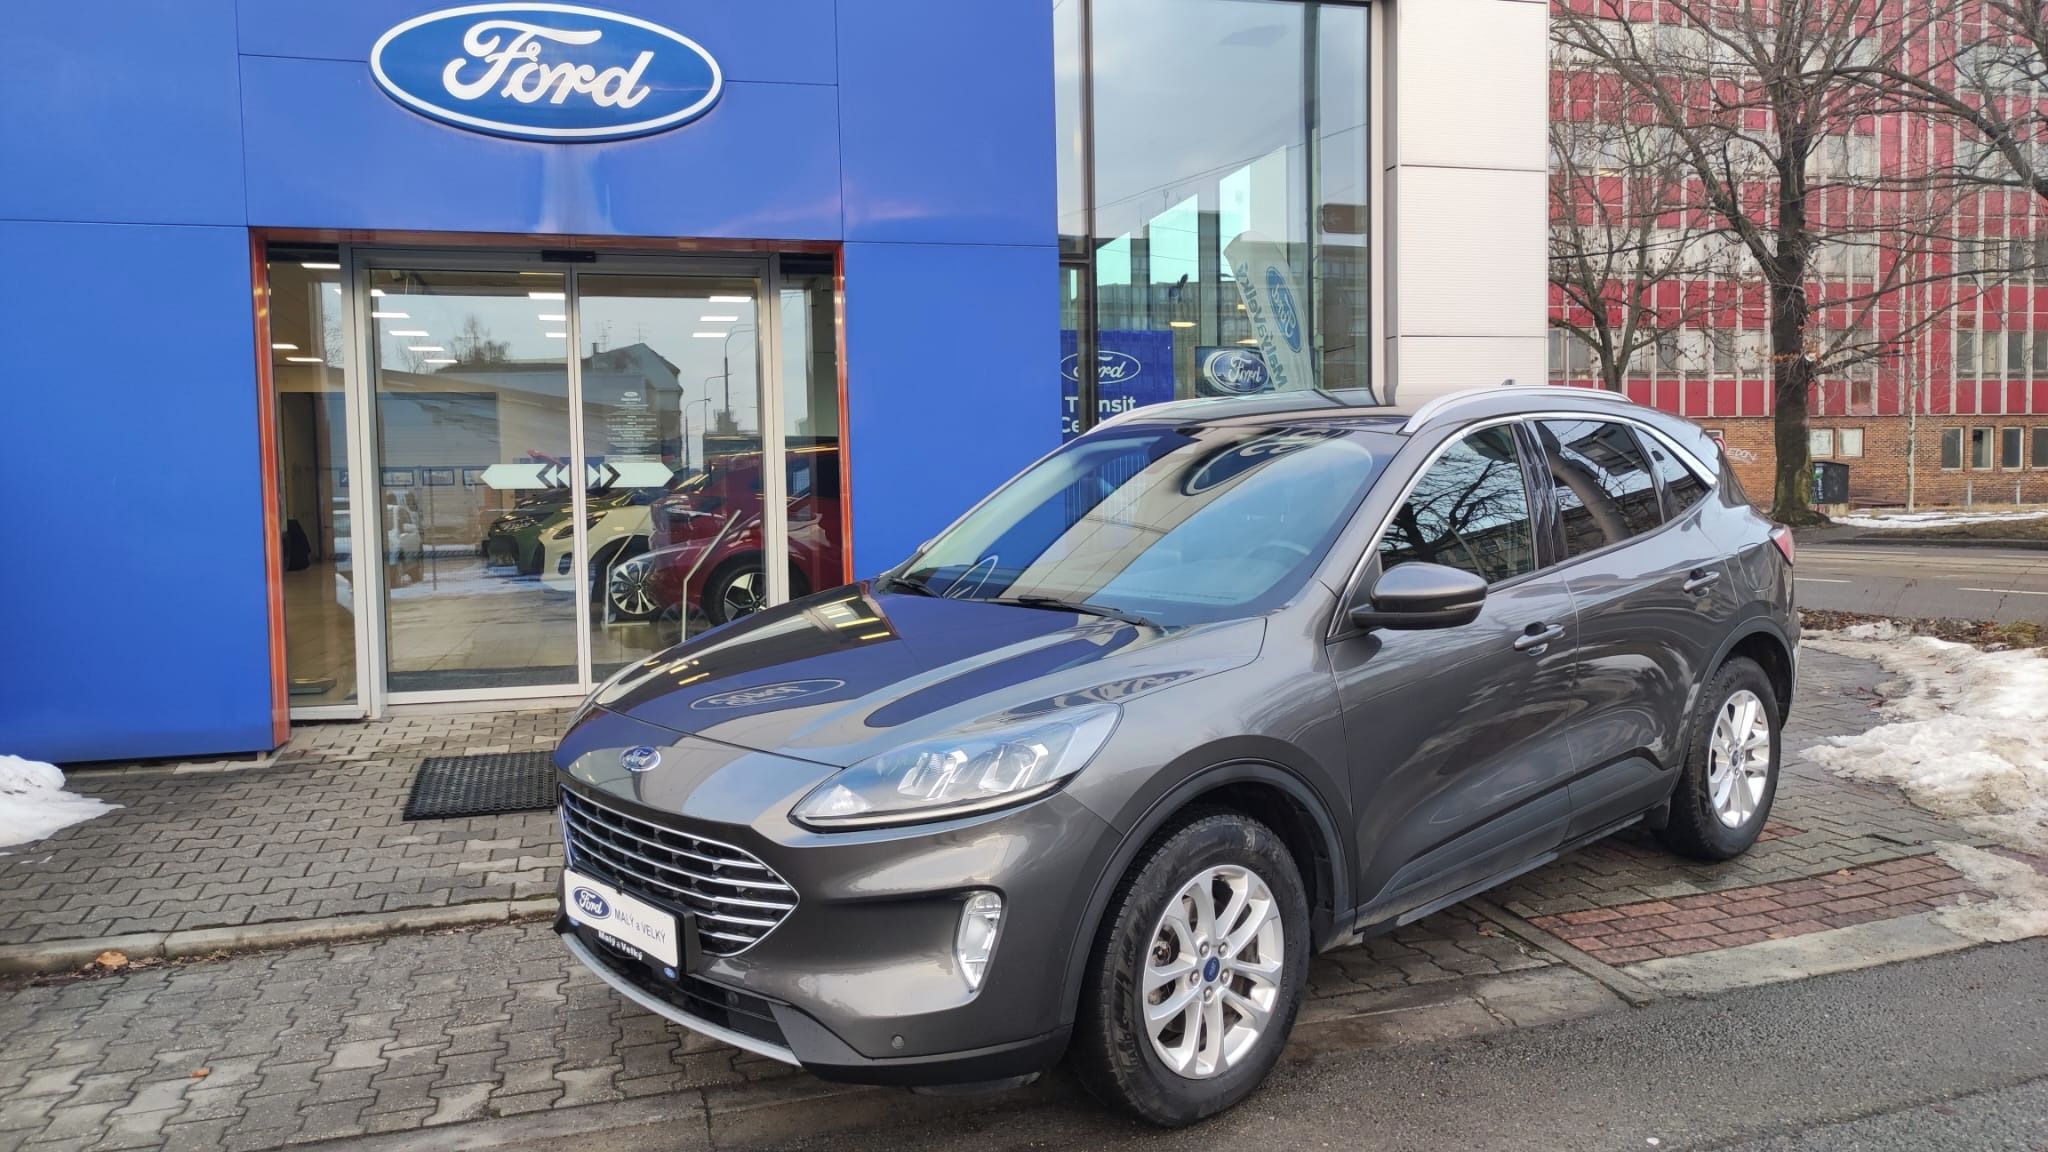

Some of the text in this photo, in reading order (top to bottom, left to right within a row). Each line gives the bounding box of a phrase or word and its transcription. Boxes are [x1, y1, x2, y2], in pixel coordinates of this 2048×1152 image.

[443, 19, 655, 109] Ford
[1073, 356, 1126, 378] rd
[1228, 357, 1262, 382] Ford
[1065, 396, 1136, 413] Tnsit
[579, 890, 602, 915] Ford
[614, 908, 634, 928] MALÝ
[641, 920, 667, 945] VELKÝ
